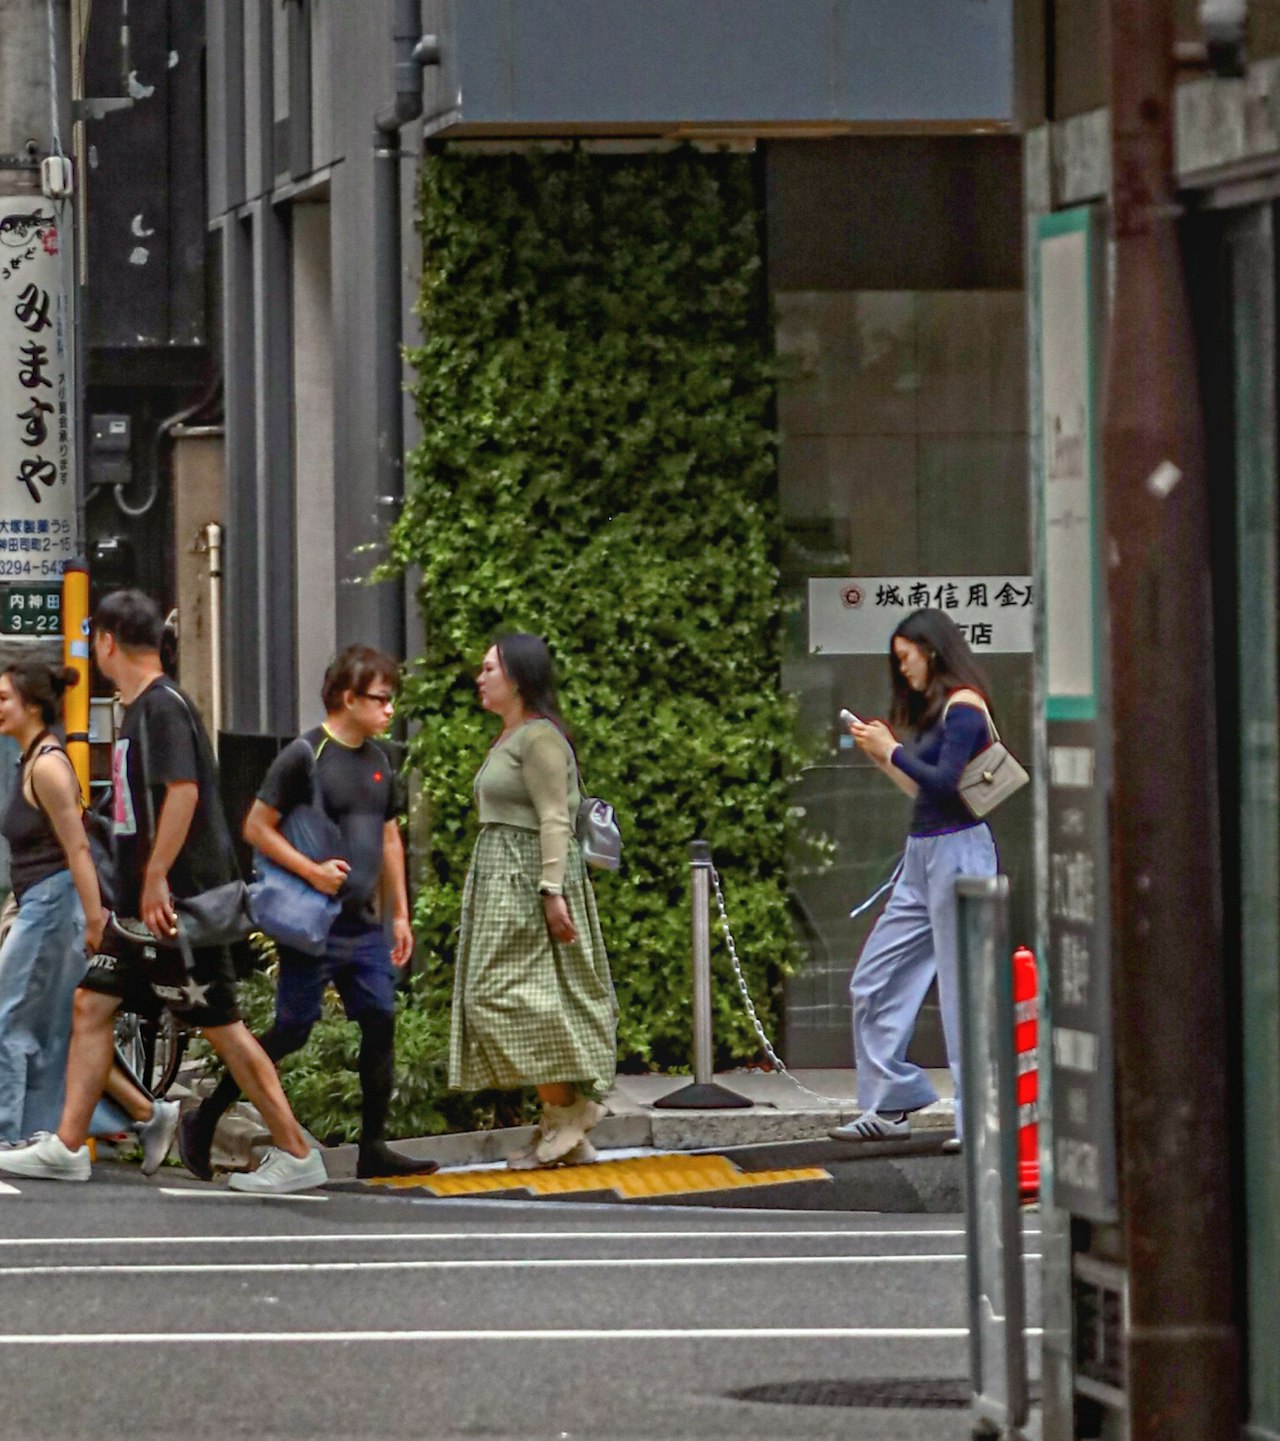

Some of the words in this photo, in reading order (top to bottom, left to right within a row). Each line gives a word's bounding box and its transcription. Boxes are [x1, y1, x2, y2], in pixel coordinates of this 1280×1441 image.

[14, 282, 57, 503] みますや
[10, 594, 59, 609] 内神田
[11, 614, 59, 630] 3-22
